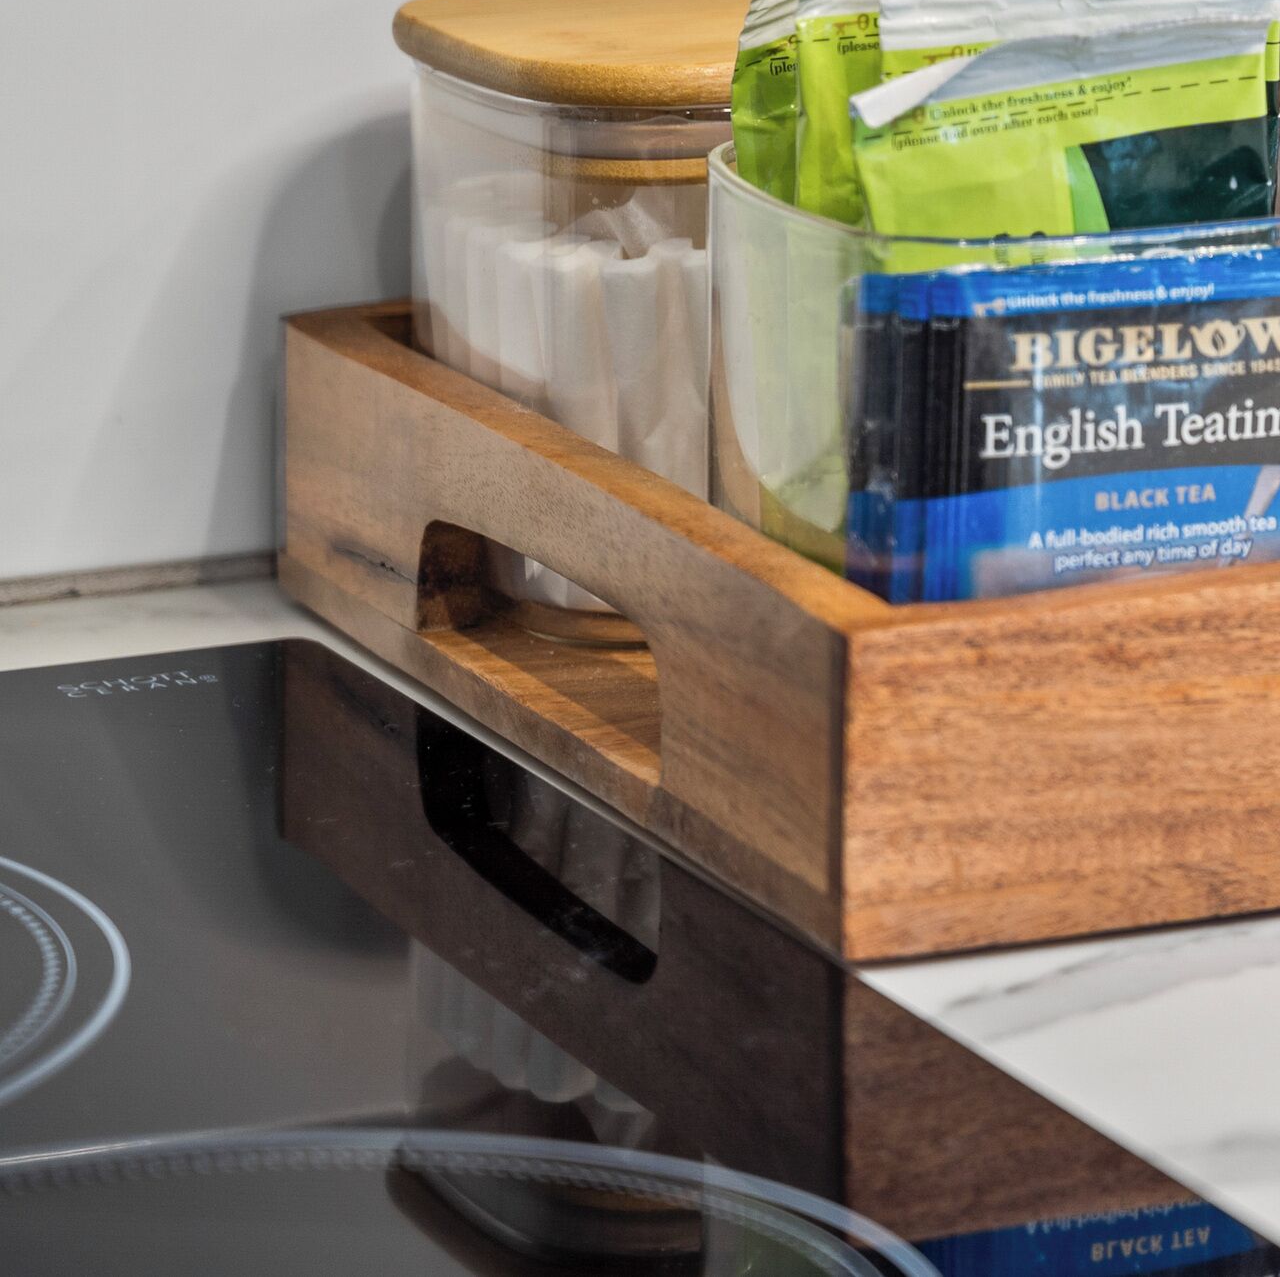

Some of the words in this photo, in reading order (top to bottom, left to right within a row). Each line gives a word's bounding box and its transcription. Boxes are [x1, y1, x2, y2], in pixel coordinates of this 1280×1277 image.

[982, 98, 1005, 112] the
[1007, 88, 1074, 108] freshness
[1077, 84, 1088, 96] &
[1091, 76, 1133, 94] enjoy!
[1037, 111, 1069, 125] each
[1071, 102, 1100, 119] use)
[1007, 291, 1059, 308] Unlock
[1061, 291, 1085, 305] the
[1087, 286, 1154, 303] freshness
[1156, 284, 1167, 300] &
[1169, 281, 1215, 301] enjoy!
[1089, 367, 1117, 384] TEA
[1121, 362, 1198, 383] BLENDERS
[1202, 359, 1247, 378] SINCE
[980, 403, 1145, 469] English
[1095, 487, 1168, 511] BLACK
[1177, 483, 1217, 506] TEA
[1028, 531, 1042, 550] A
[1046, 524, 1142, 547] full-bodied
[1146, 519, 1178, 540] rich
[1181, 514, 1247, 537] smooth
[1249, 514, 1277, 532] tea
[1053, 548, 1119, 573] perfect
[1122, 546, 1155, 566] any
[1157, 543, 1196, 563] time
[1199, 540, 1219, 559] of
[1220, 537, 1253, 560] day
